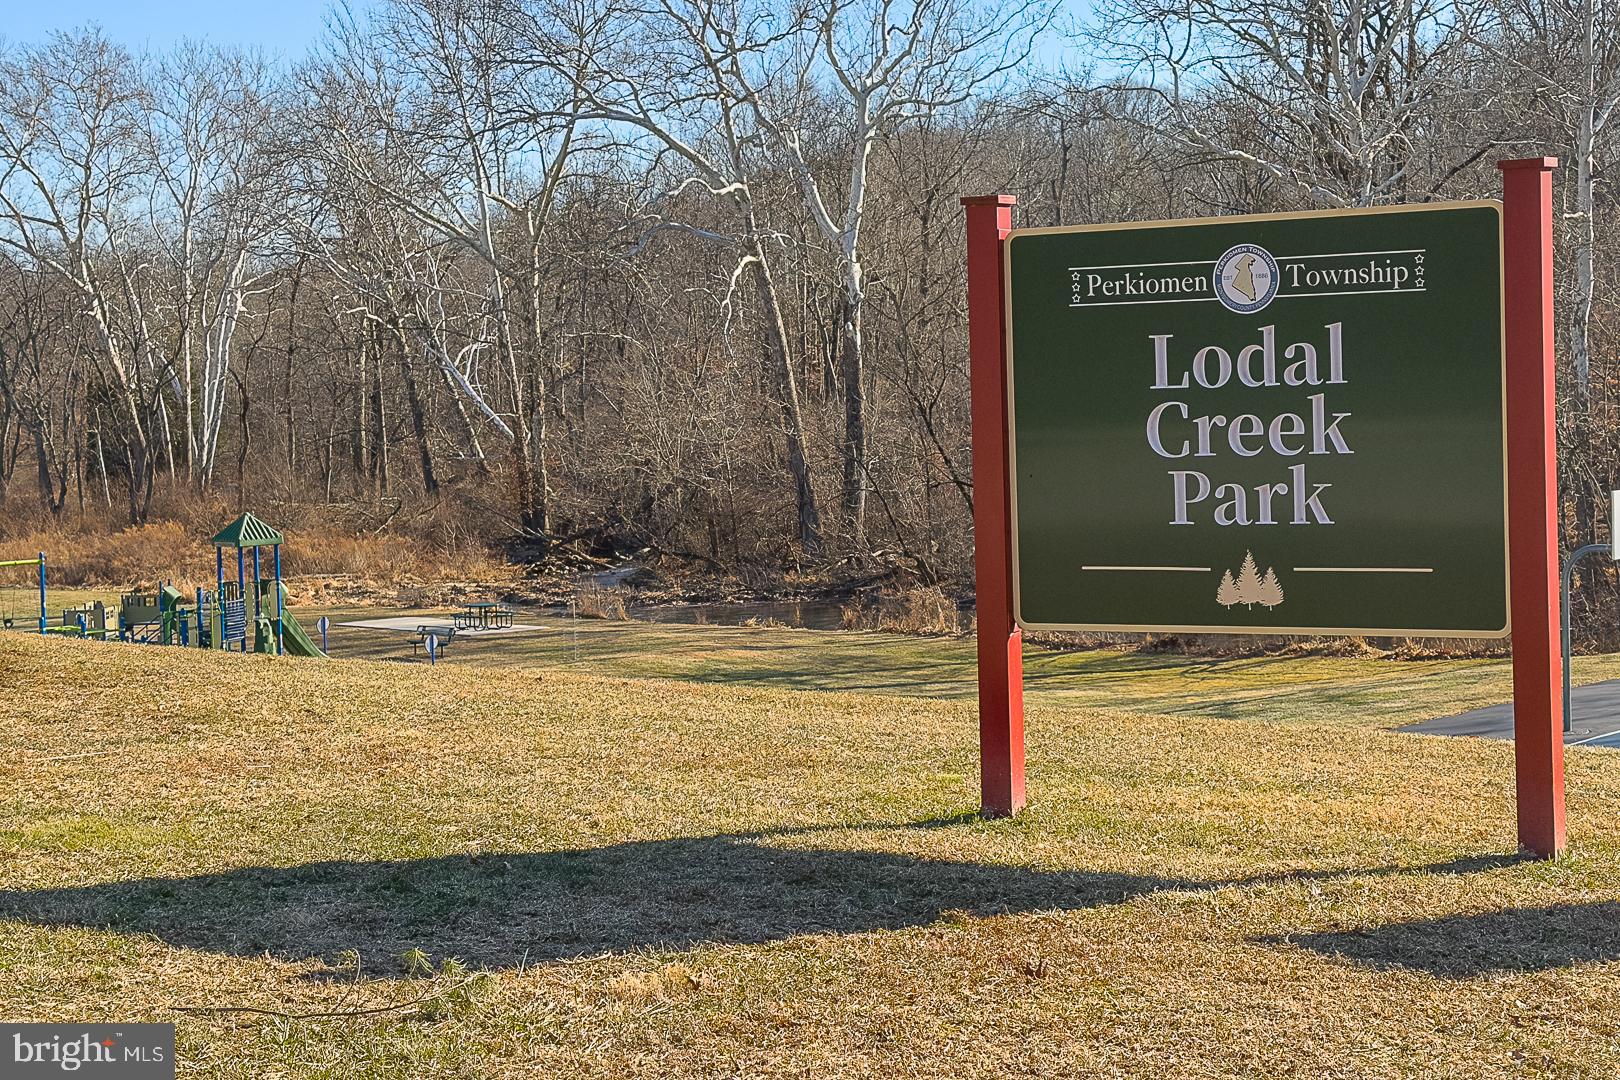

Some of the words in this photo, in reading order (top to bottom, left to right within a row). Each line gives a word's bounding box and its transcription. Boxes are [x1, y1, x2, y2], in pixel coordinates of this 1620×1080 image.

[1086, 272, 1208, 297] Perkiomen
[1286, 259, 1409, 290] Township
[1248, 246, 1276, 273] TOWNSHIP
[1148, 322, 1348, 389] Lodal
[1146, 393, 1355, 458] Creek
[1168, 464, 1335, 526] Park
